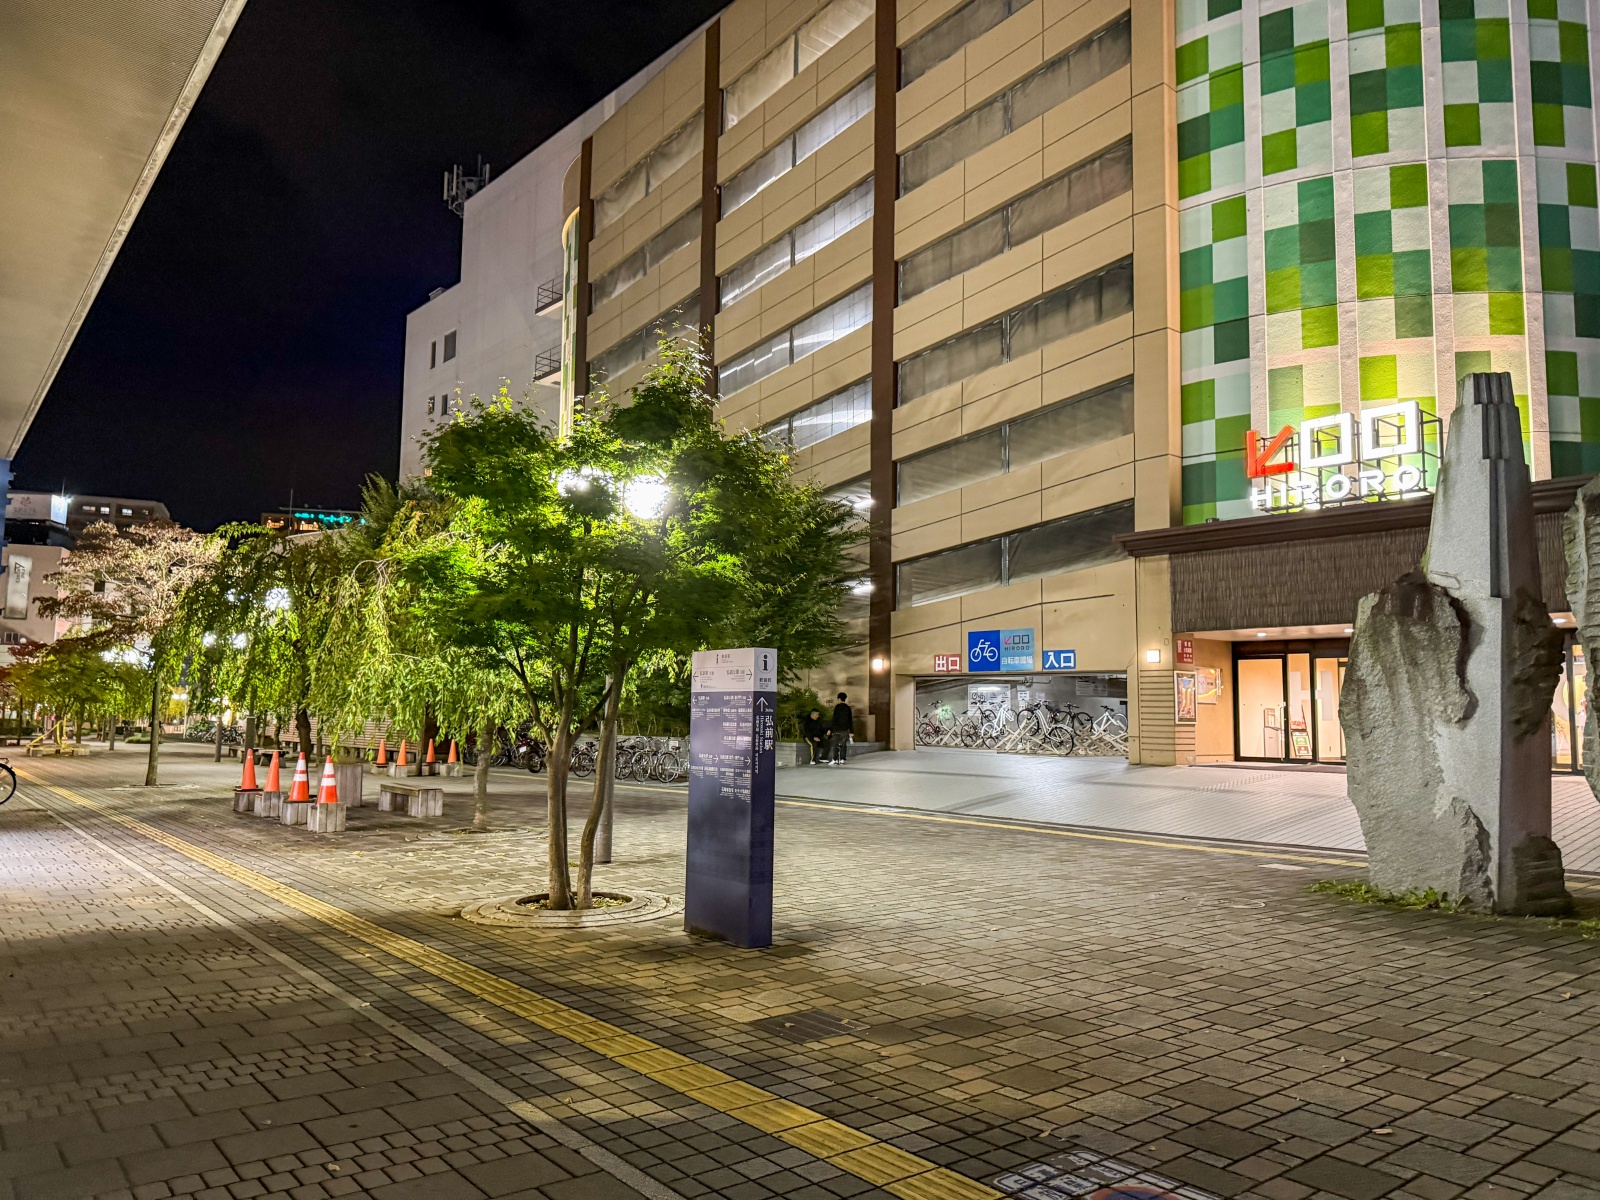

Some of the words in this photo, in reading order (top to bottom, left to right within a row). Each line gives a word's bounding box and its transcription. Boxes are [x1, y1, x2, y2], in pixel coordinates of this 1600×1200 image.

[1250, 465, 1422, 510] HIRORO
[935, 655, 960, 672] 出口
[1045, 651, 1075, 668] 入口
[764, 715, 774, 751] 弘前駅
